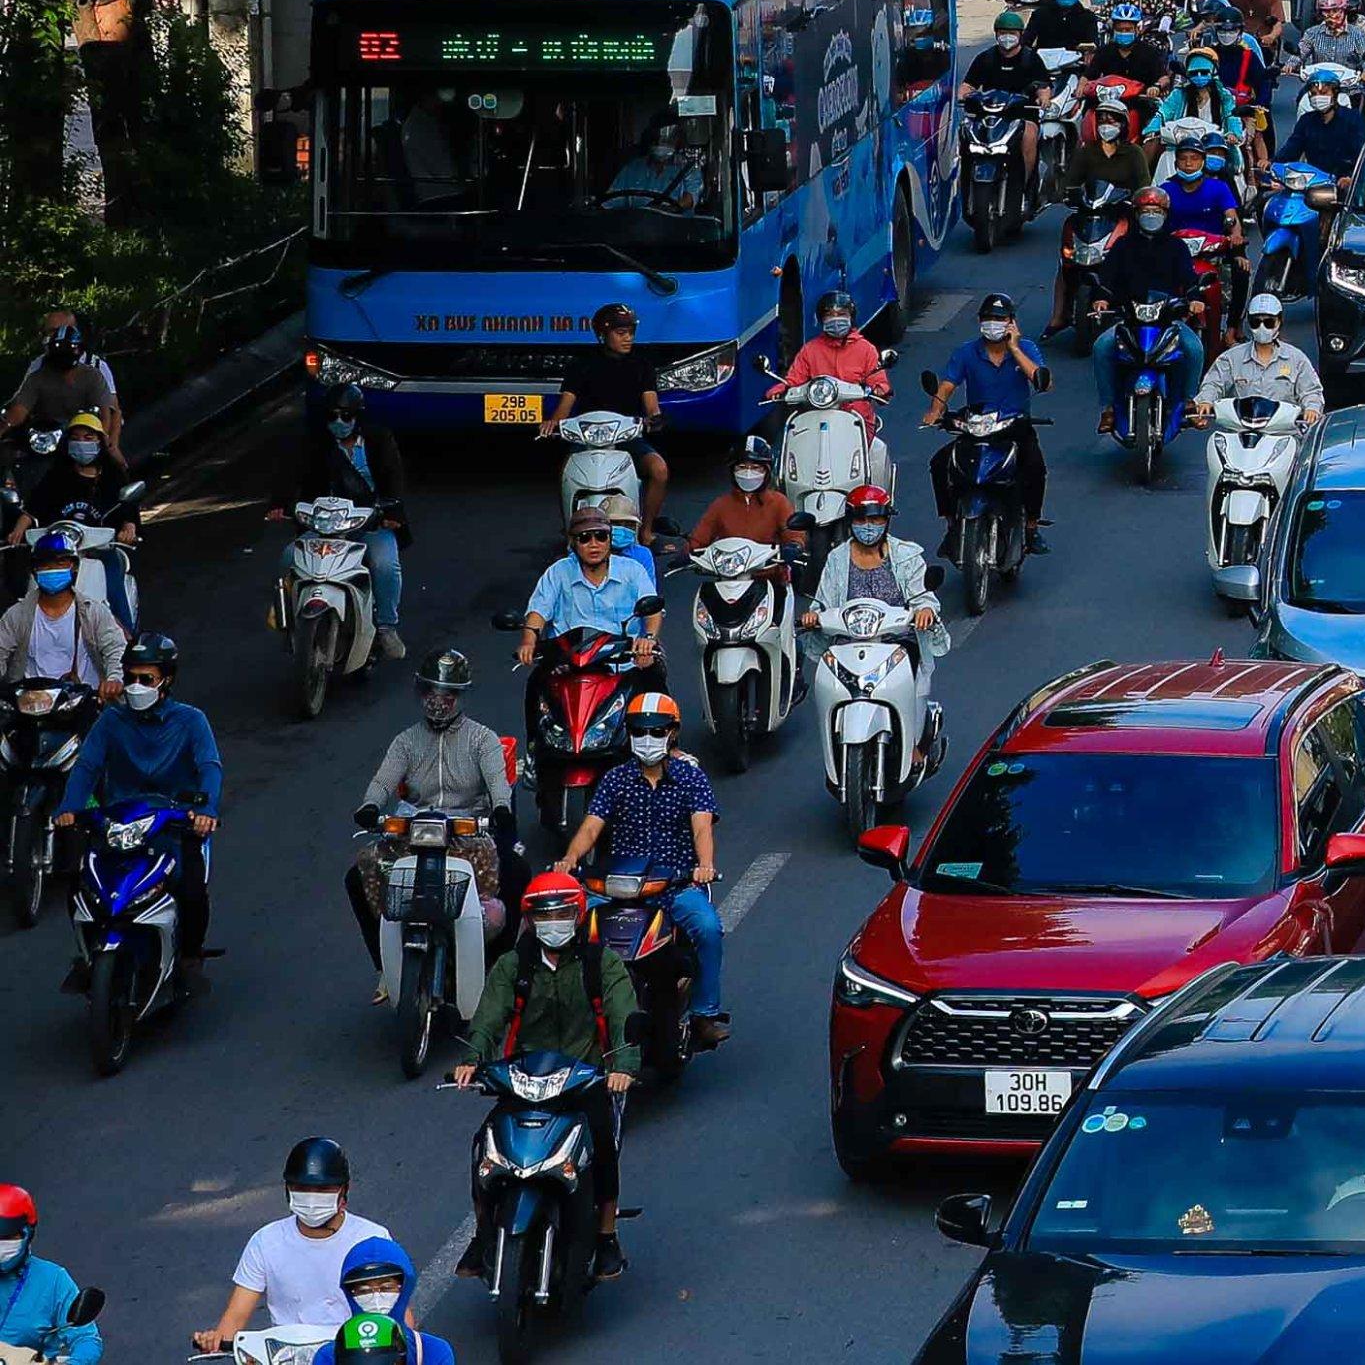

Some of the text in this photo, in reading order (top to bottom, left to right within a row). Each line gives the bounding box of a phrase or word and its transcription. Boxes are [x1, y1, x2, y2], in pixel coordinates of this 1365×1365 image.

[501, 396, 526, 409] 29B
[491, 409, 537, 422] 205.05
[1009, 1073, 1046, 1091] 30H
[996, 1094, 1063, 1112] 109.86
